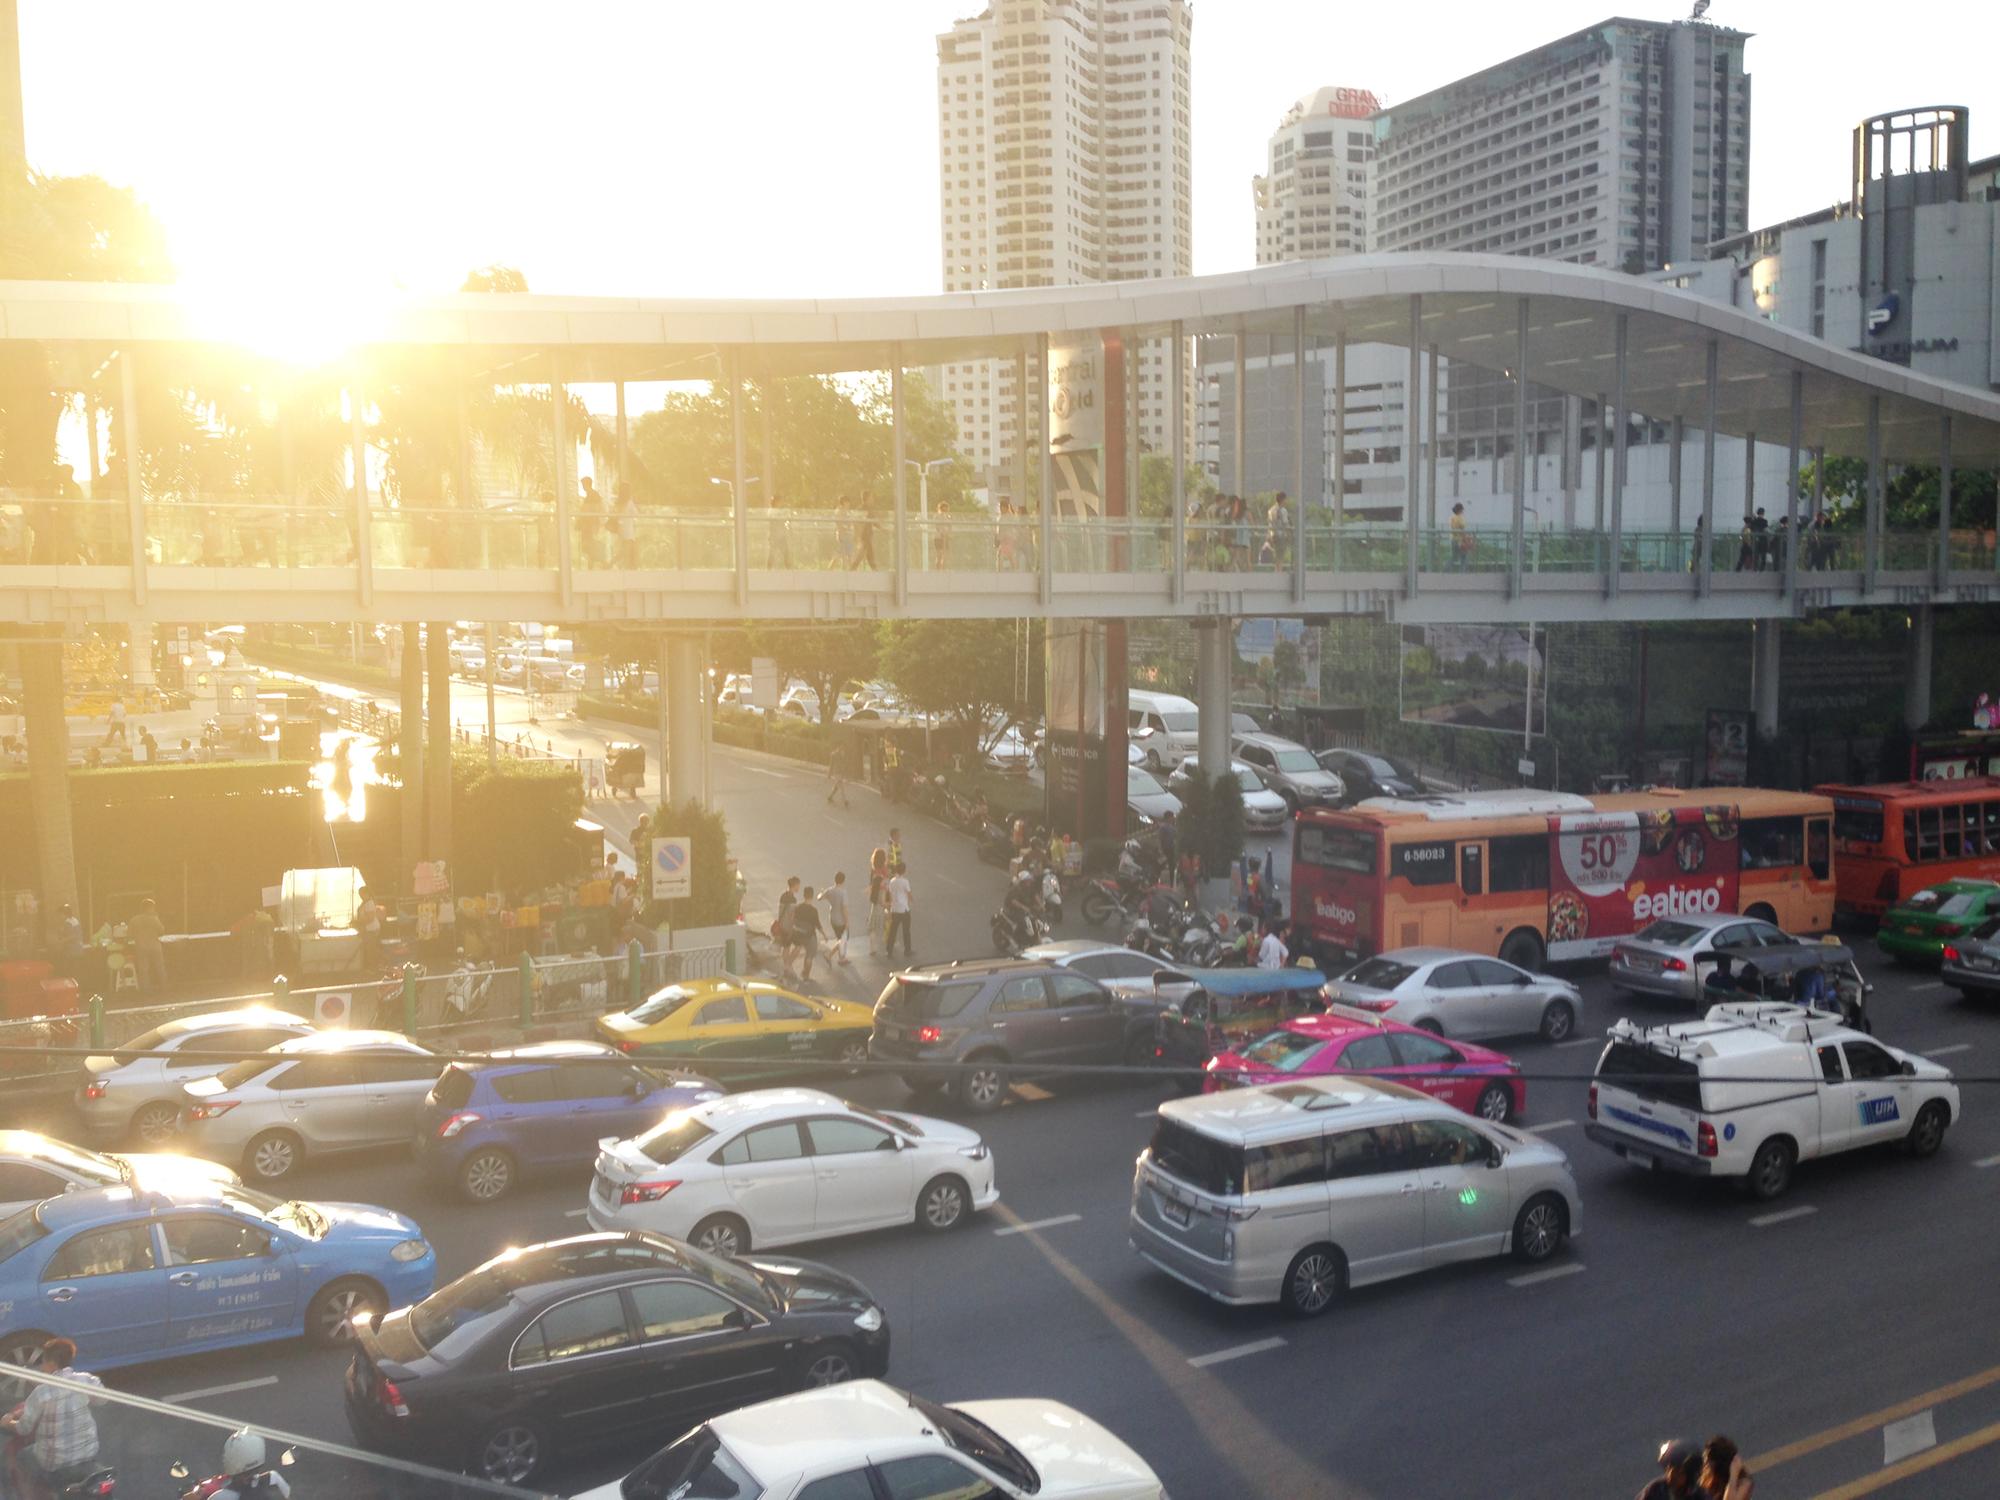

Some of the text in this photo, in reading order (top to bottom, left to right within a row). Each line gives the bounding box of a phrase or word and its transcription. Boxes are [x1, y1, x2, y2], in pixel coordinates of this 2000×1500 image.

[1061, 746, 1098, 761] entrnce
[1316, 902, 1356, 925] eatigo
[1633, 884, 1720, 921] eatigo
